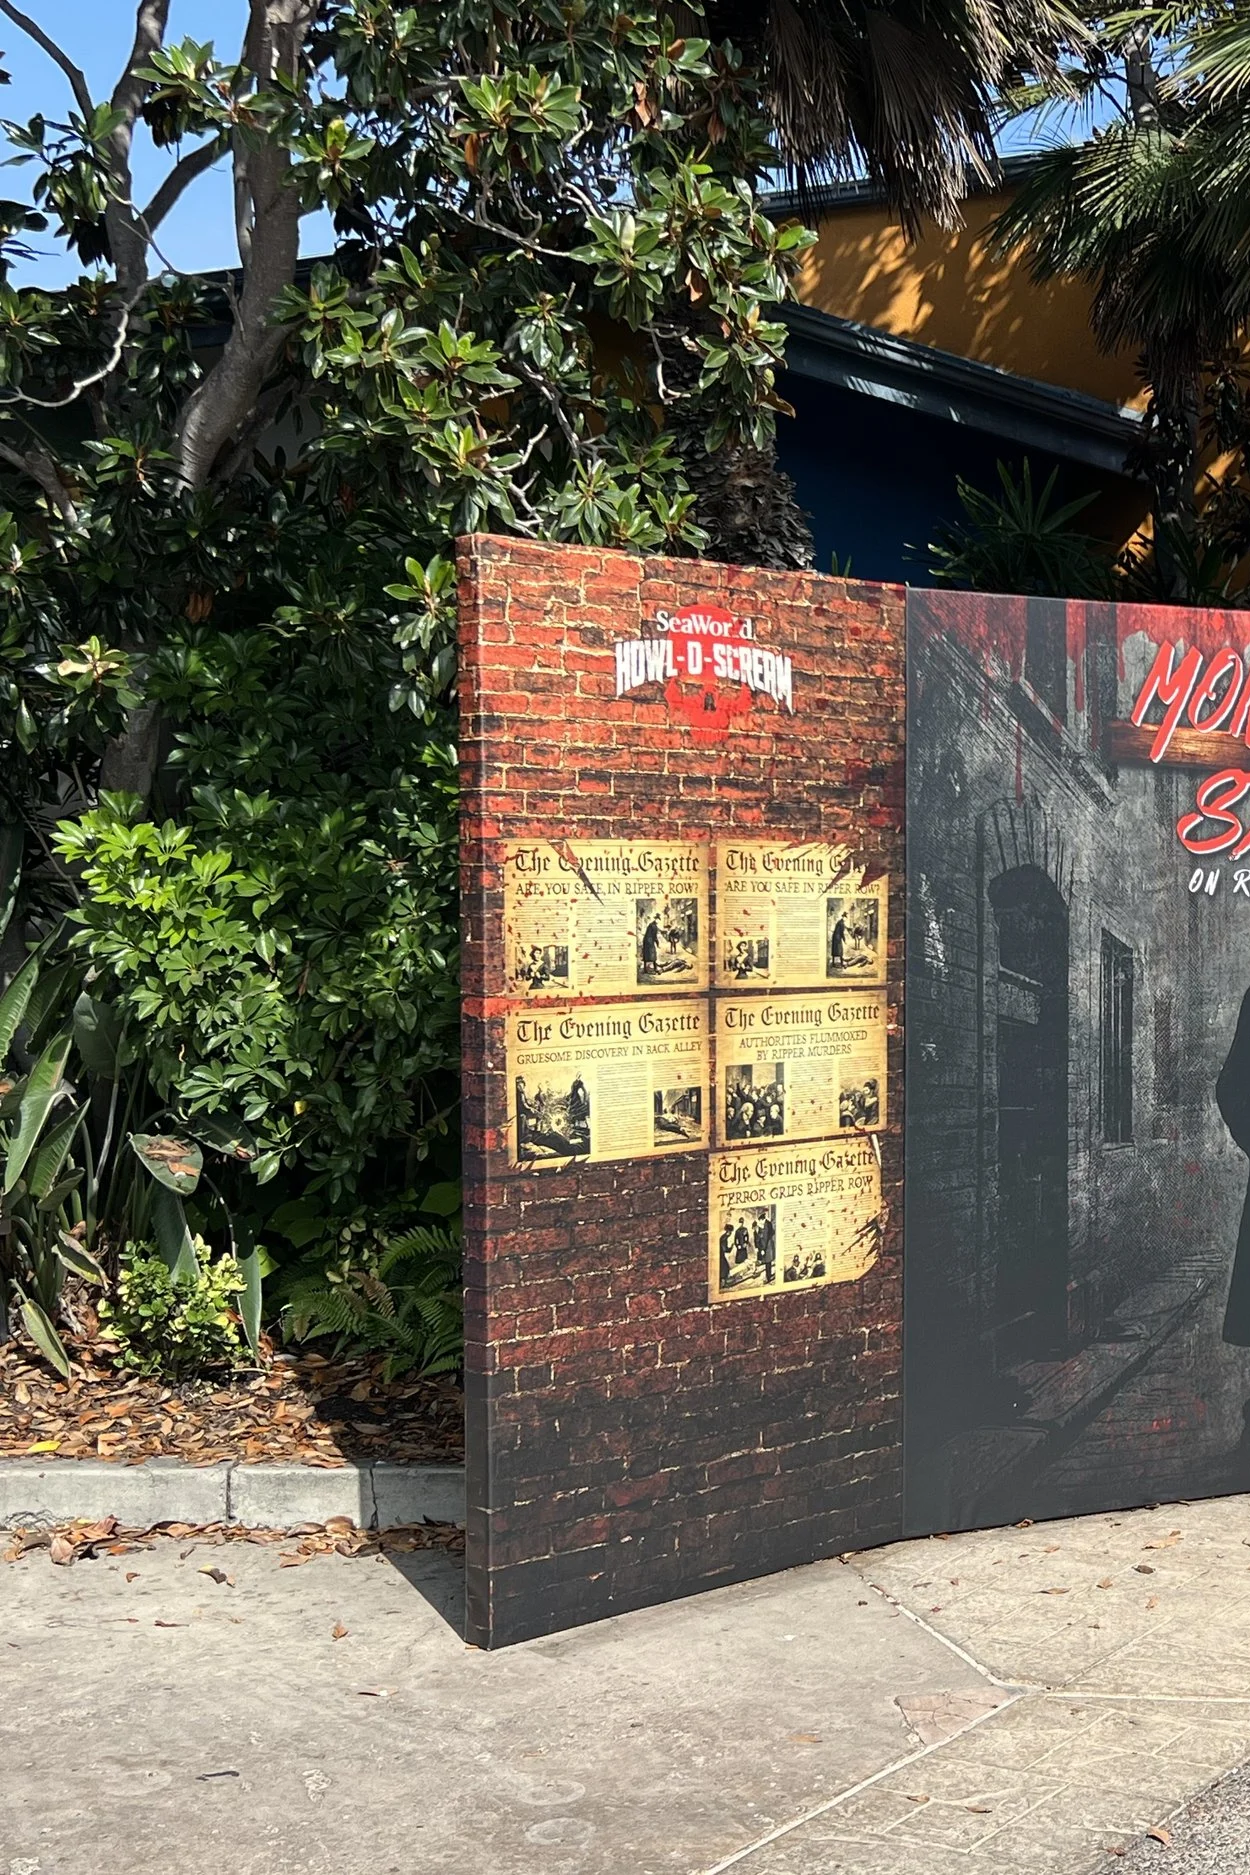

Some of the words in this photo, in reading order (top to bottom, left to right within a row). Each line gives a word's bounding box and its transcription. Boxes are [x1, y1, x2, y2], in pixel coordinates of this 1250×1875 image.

[615, 639, 794, 716] HOWL-O-SCREAM
[515, 849, 550, 875] The
[638, 850, 700, 873] Gazette
[726, 849, 757, 874] The
[762, 849, 823, 876] Evening
[515, 883, 541, 895] ARE
[545, 883, 570, 894] YOU
[608, 883, 620, 894] IN
[625, 883, 664, 895] RIPPER
[669, 882, 699, 894] ROW?
[726, 880, 747, 892] ARE
[751, 881, 772, 893] YOU
[775, 882, 799, 893] SAFE
[802, 882, 814, 893] IN
[1188, 868, 1220, 896] ON
[517, 1020, 552, 1045] The
[559, 1016, 632, 1039] Evening
[638, 1013, 700, 1036] Gazette
[725, 1007, 755, 1031] The
[761, 1004, 822, 1027] Evening
[827, 1002, 880, 1025] Gazette
[517, 1052, 572, 1065] GRUESOME
[575, 1046, 629, 1061] DISCOVERY
[632, 1045, 643, 1056] IN
[647, 1043, 670, 1054] BACK
[673, 1041, 703, 1052] ALLEY
[739, 1034, 807, 1049] AUTHORITIES
[809, 1030, 868, 1044] FLUMMOXED
[756, 1050, 768, 1061] BY
[772, 1047, 805, 1059] RIPPER
[808, 1044, 852, 1057] MURDERS
[719, 1158, 750, 1185] The
[755, 1156, 816, 1179] Evening
[821, 1150, 874, 1171] Gazette
[717, 1189, 766, 1207] TERROR
[769, 1184, 803, 1199] GRIPS
[807, 1179, 844, 1195] RIPPER
[848, 1175, 873, 1190] ROW
